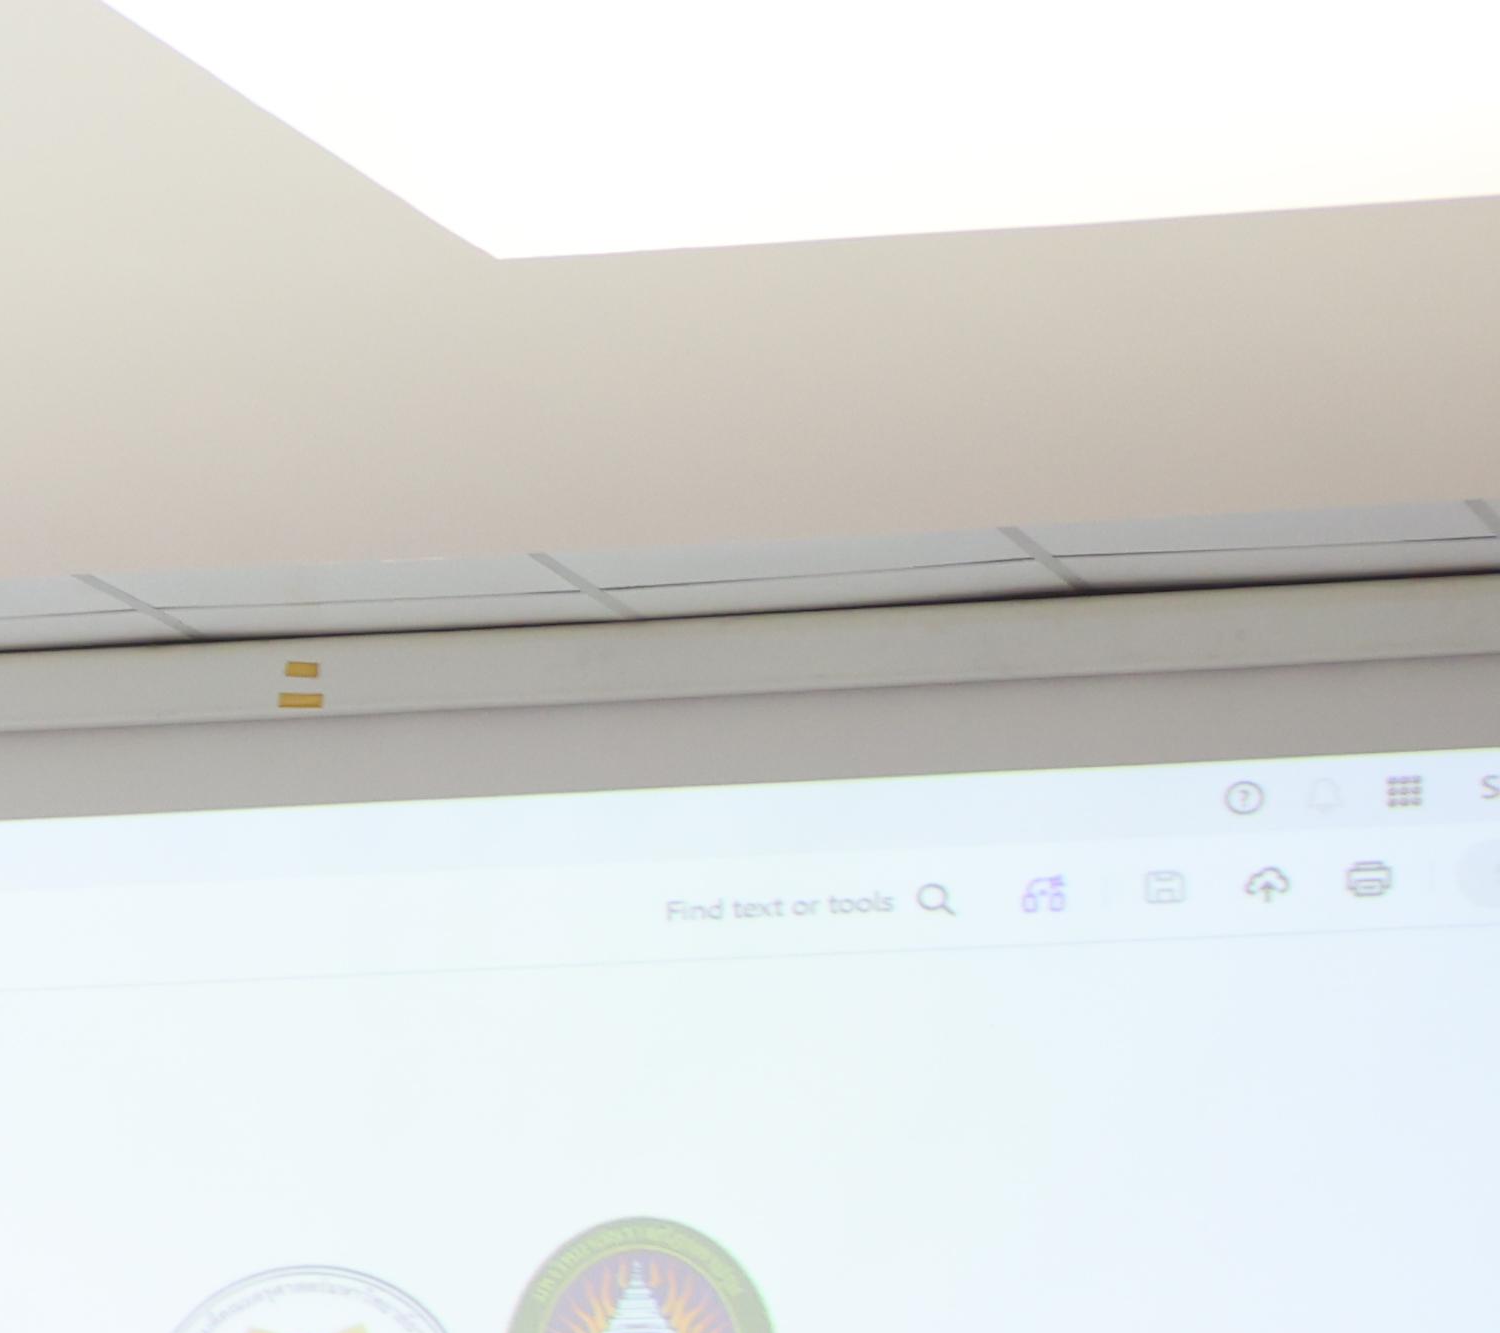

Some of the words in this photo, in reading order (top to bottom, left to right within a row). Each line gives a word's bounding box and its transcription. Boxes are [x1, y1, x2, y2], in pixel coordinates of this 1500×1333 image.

[666, 898, 724, 923] Find
[732, 899, 784, 920] text
[791, 900, 820, 917] or
[826, 891, 895, 915] tools
